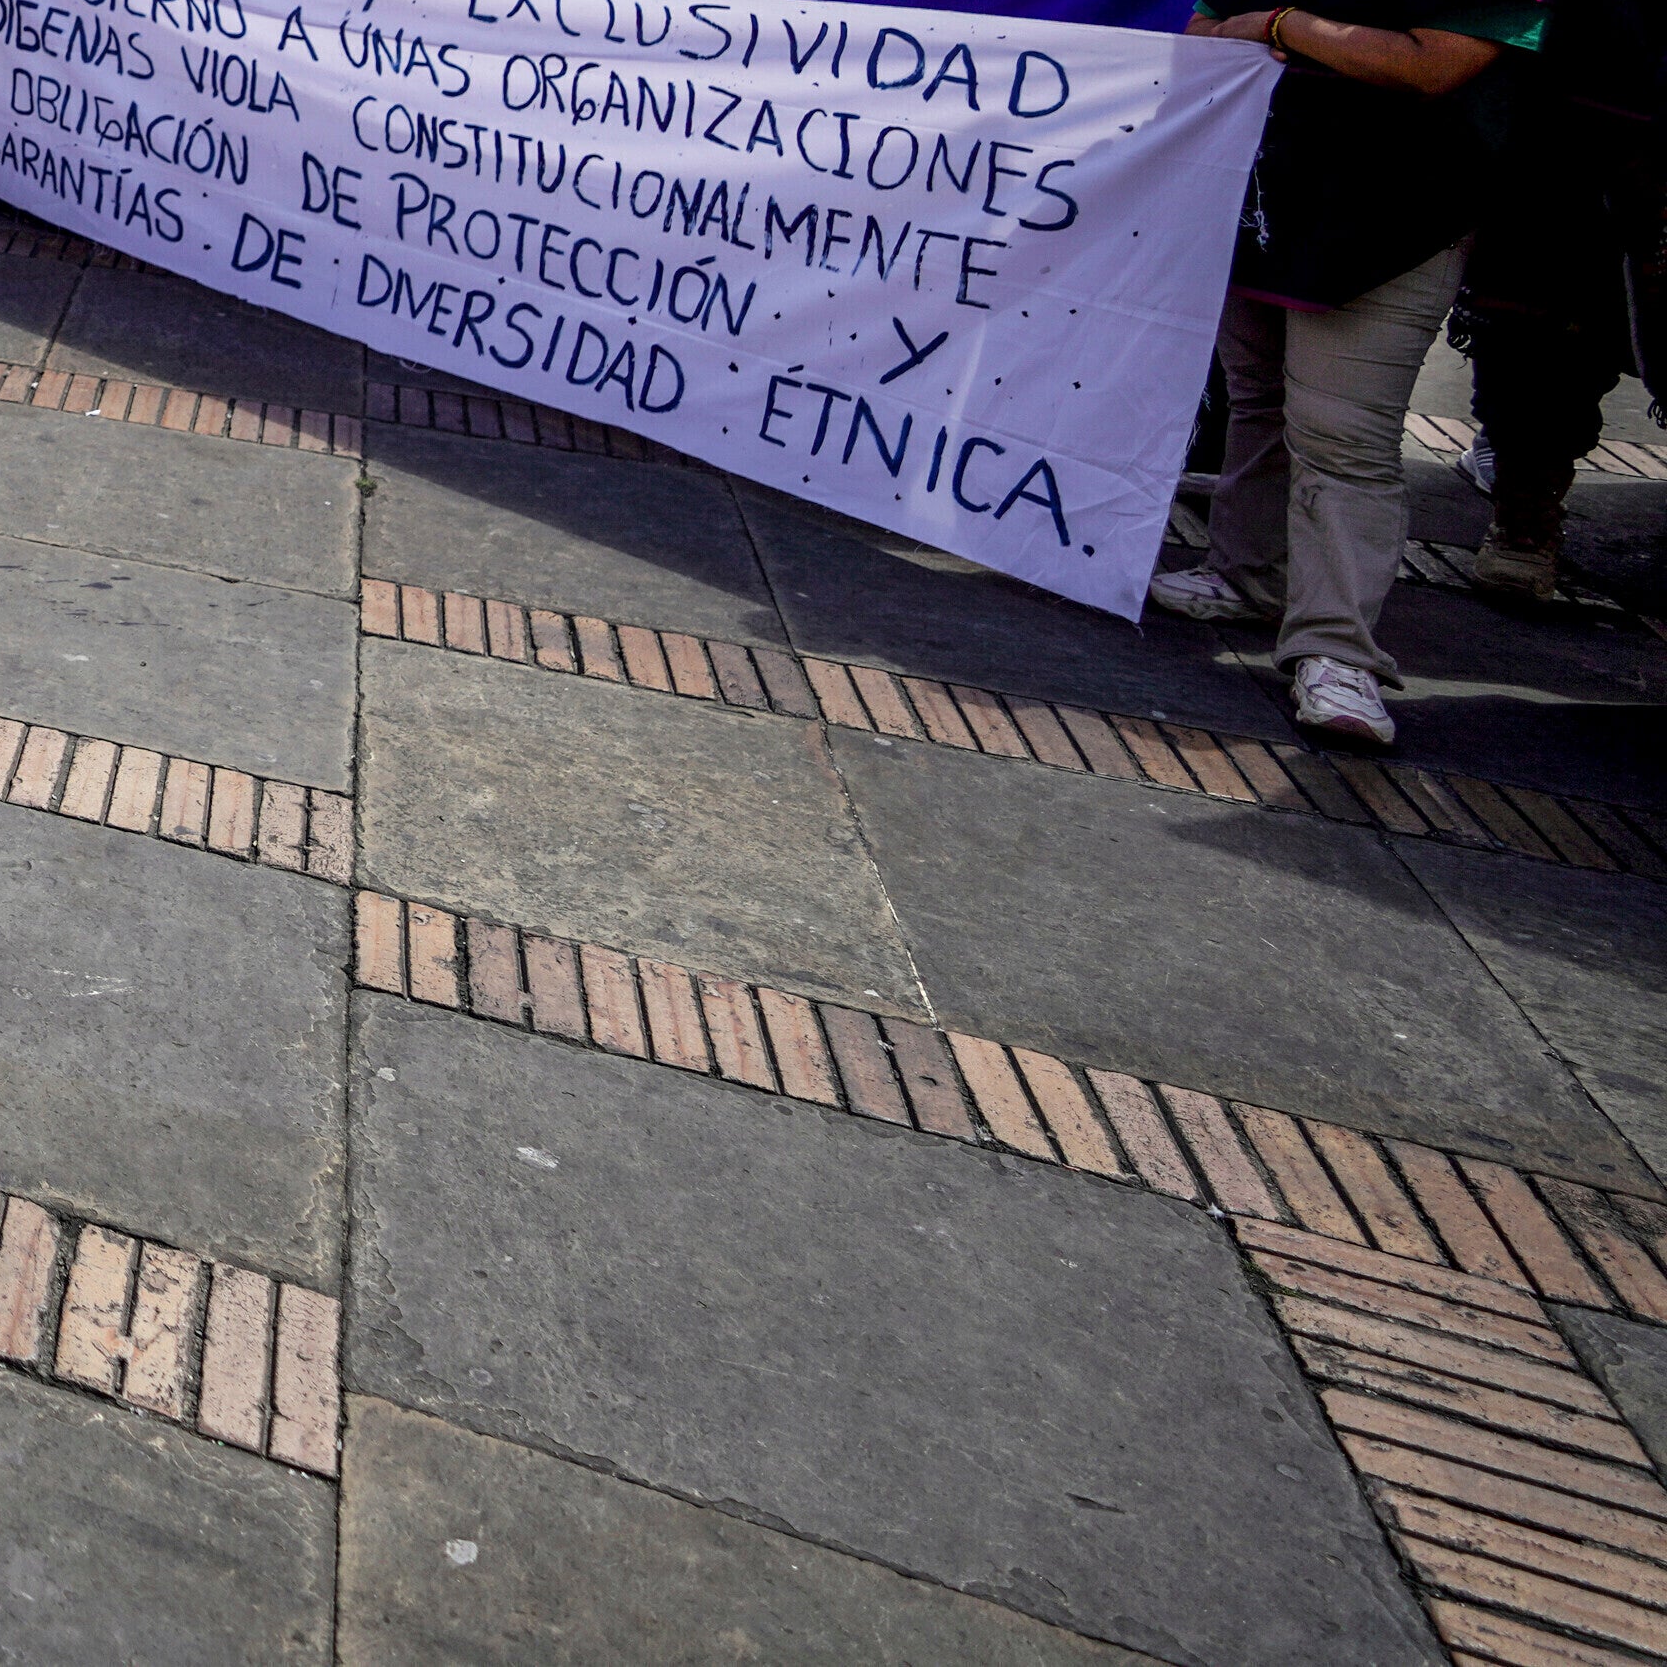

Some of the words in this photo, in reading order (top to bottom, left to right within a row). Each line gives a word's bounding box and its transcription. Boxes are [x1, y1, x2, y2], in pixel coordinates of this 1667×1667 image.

[9, 67, 250, 186] OBLIGACIÓN
[301, 151, 363, 231] DE
[388, 172, 758, 337] PROTECCIÓN
[879, 316, 951, 386] Y
[181, 44, 300, 122] VIOLA
[352, 95, 1009, 310] CONSTITUCIONALMENTE
[277, 5, 319, 62] A
[339, 17, 470, 97] UNAS
[502, 52, 1079, 232] ORGANIZACIONES
[230, 212, 307, 290] DE
[356, 252, 687, 415] DIVERSIDAD
[758, 363, 1097, 558] ÉTNICA.
